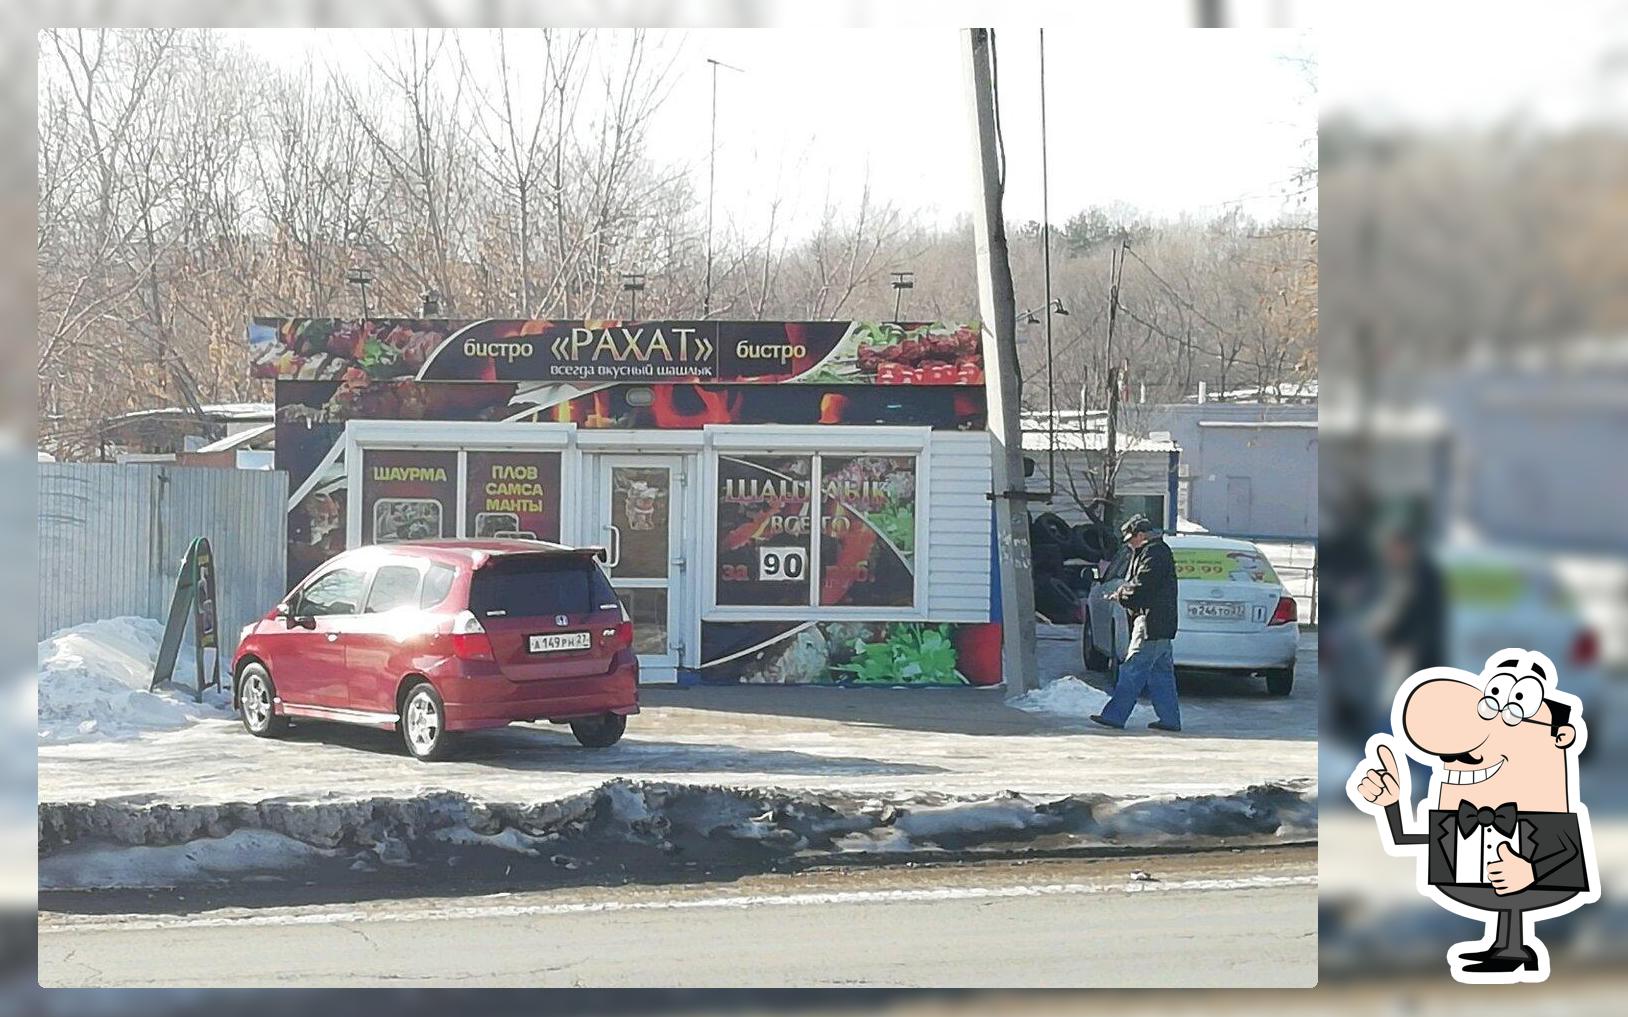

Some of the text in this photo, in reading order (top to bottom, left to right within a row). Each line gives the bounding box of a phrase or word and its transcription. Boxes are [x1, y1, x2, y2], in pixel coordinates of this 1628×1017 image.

[463, 338, 534, 362] бистро
[551, 327, 714, 362] «РАХАТ»
[735, 339, 807, 363] бистро
[550, 364, 712, 379] всегда вкусный шашлык
[373, 467, 447, 482] ШАУРМА
[492, 466, 538, 480] ПЛОВ
[485, 482, 543, 496] САМСА
[485, 499, 543, 512] МАНТЫ
[763, 553, 803, 578] 90
